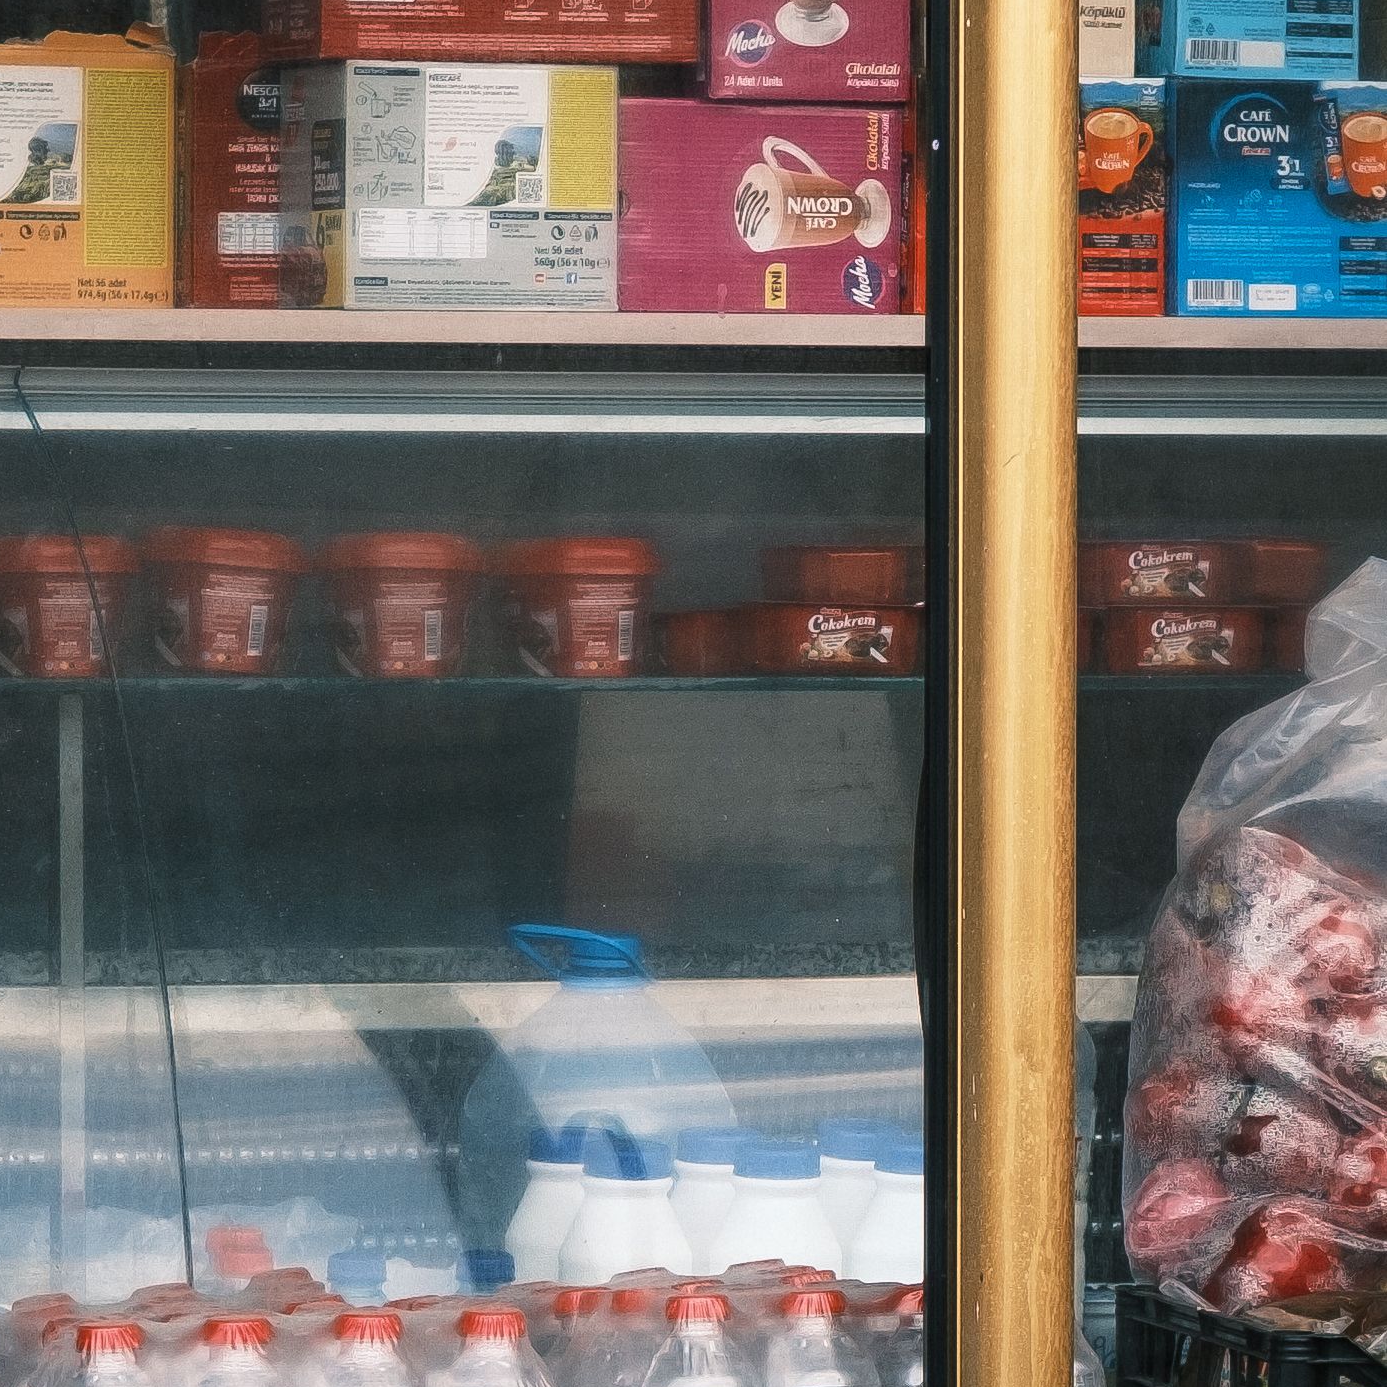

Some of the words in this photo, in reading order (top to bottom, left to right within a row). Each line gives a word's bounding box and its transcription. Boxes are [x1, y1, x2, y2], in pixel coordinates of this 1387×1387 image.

[724, 27, 777, 57] Mocha
[724, 75, 736, 87] 24
[1239, 108, 1272, 122] CAFÉ
[1223, 123, 1290, 143] CROWN
[786, 196, 853, 216] CROWN
[770, 270, 783, 301] YENİ
[851, 255, 876, 310] Mocha
